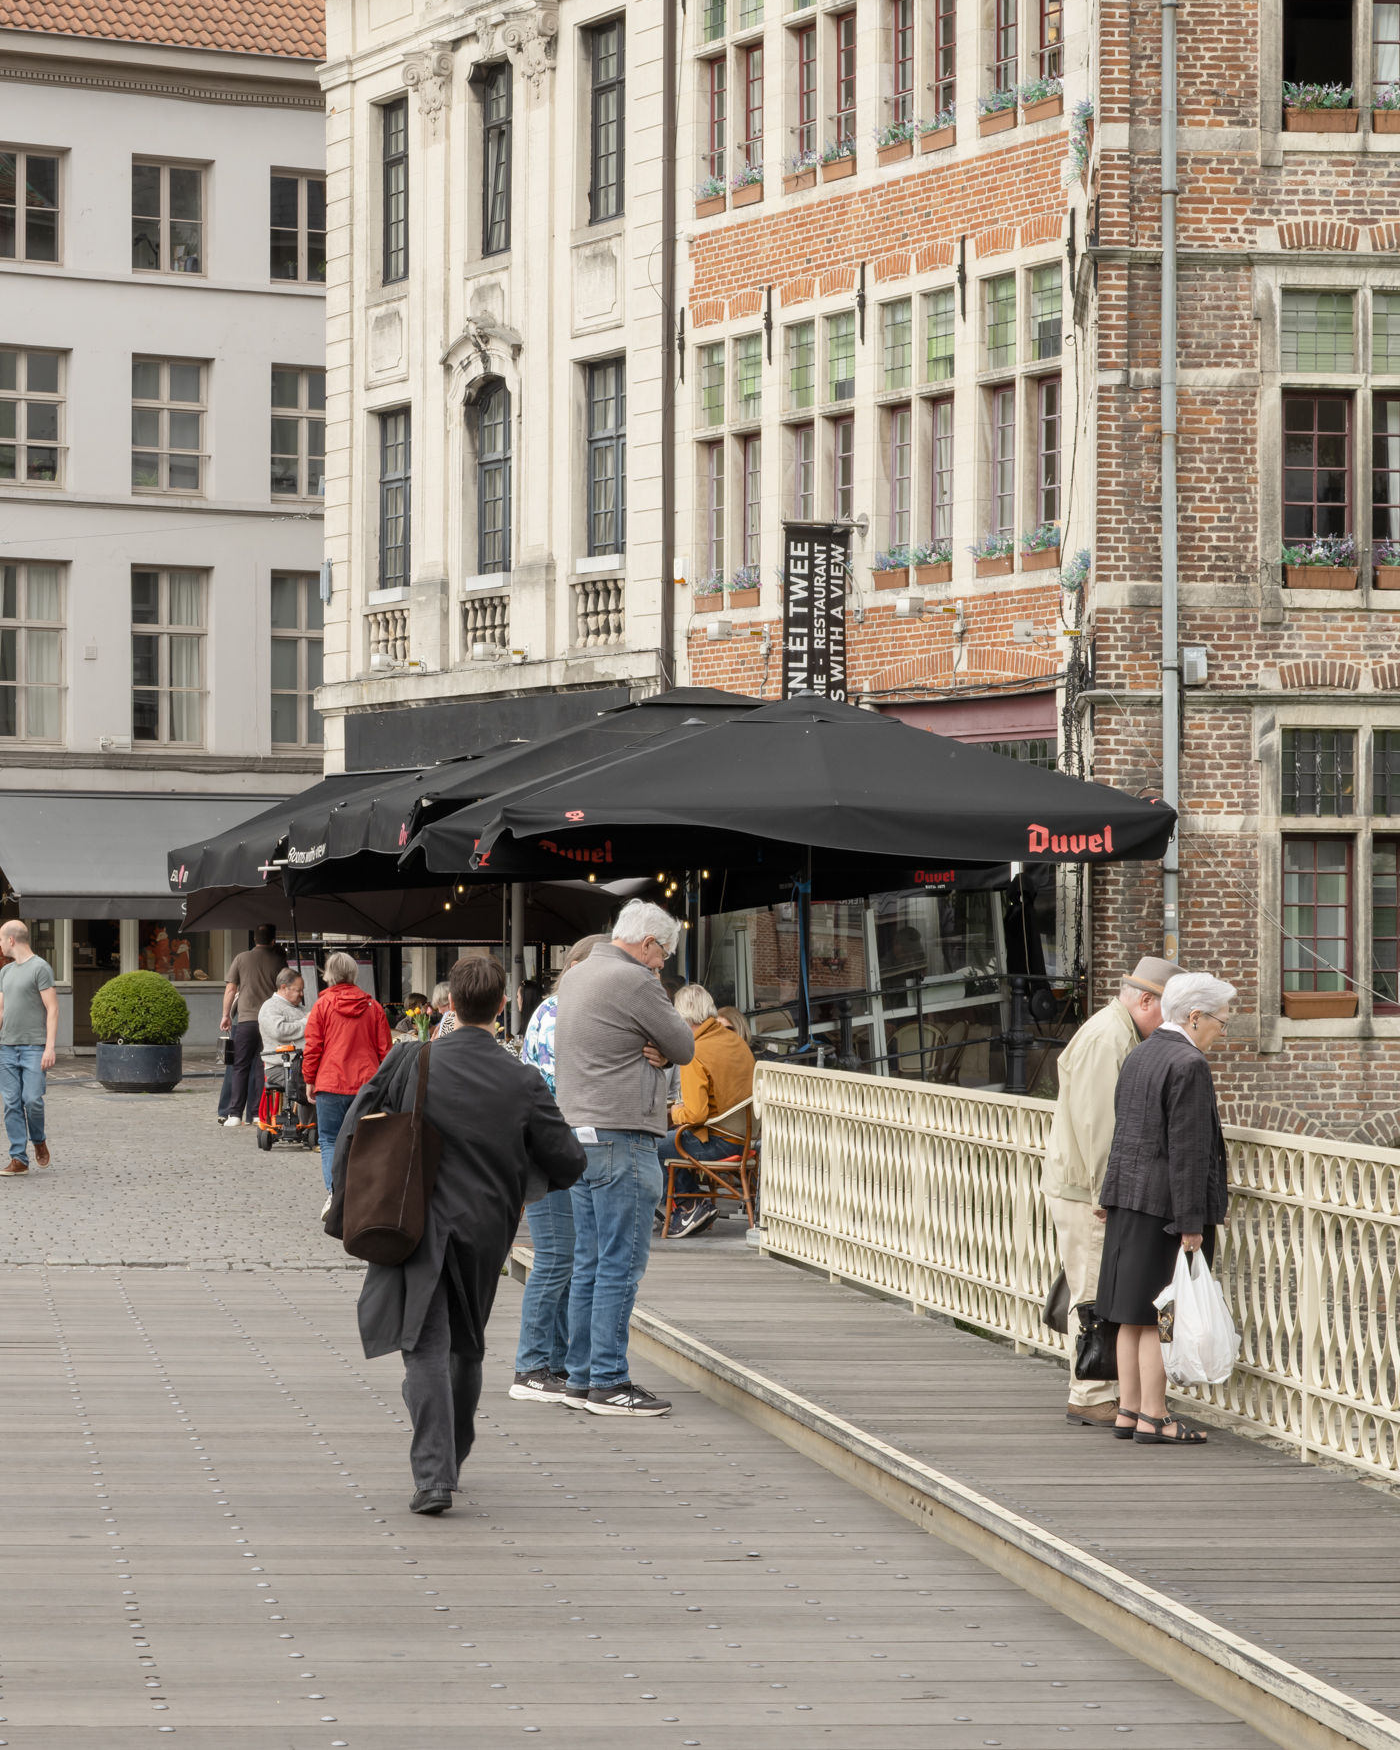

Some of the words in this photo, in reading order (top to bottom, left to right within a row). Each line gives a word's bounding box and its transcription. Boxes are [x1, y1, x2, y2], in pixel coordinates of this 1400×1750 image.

[789, 541, 809, 617] TWEE
[813, 542, 827, 649] RESTAURANT
[830, 543, 845, 599] VIEW
[829, 605, 844, 620] A
[788, 627, 808, 700] NLEI
[829, 627, 844, 682] WITH
[1027, 823, 1114, 854] Duvel
[914, 869, 956, 884] Duvel
[526, 1379, 545, 1391] HOKA
